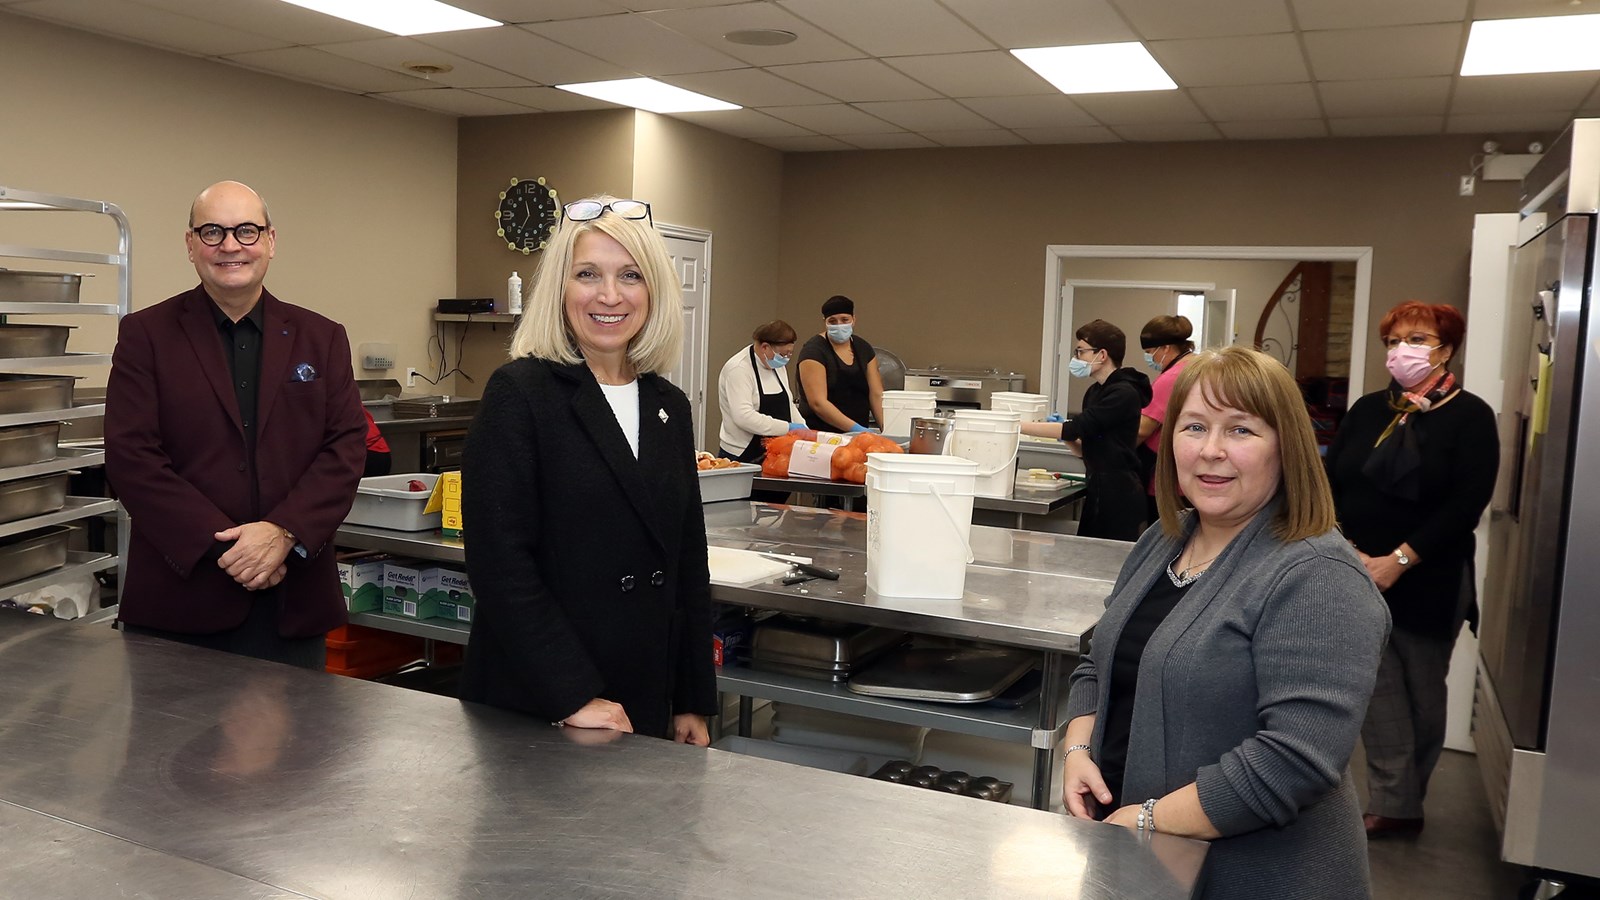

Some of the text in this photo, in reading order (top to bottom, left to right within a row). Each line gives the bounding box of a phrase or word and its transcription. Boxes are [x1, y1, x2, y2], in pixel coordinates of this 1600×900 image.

[525, 184, 535, 194] 12
[387, 571, 398, 579] Get
[441, 575, 452, 583] Get
